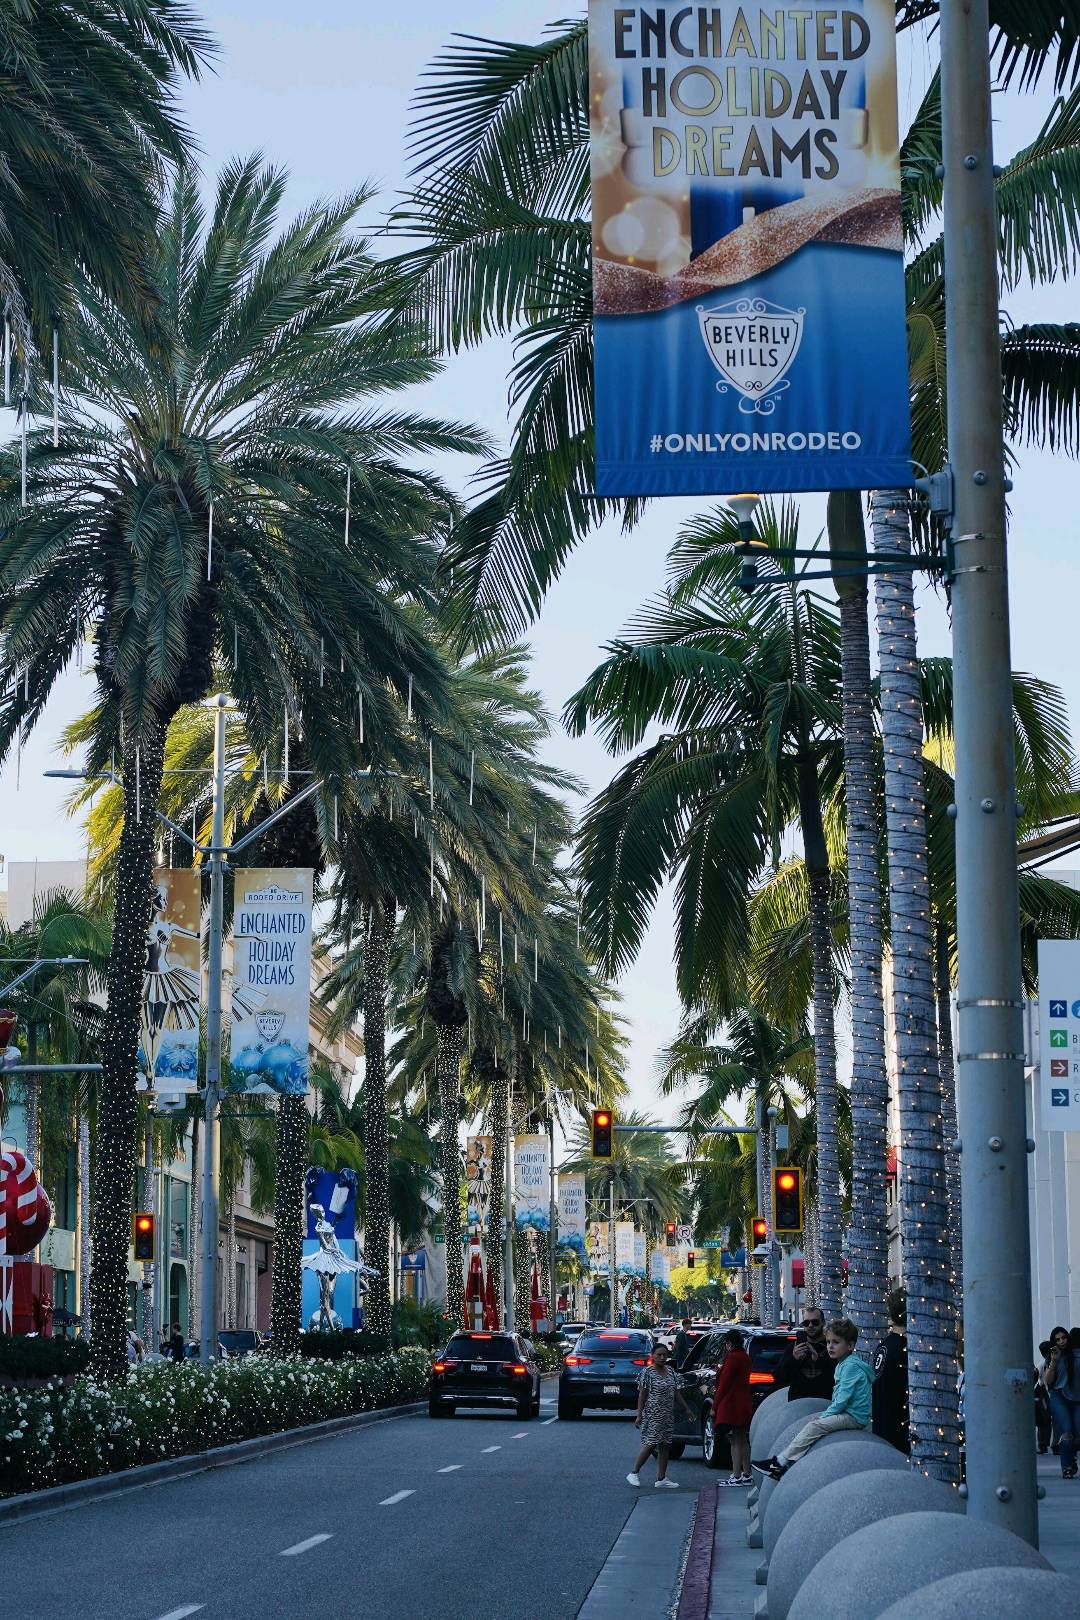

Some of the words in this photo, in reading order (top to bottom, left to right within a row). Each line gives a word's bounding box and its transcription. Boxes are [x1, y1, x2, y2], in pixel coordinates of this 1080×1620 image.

[614, 7, 871, 61] ENCHANTED
[642, 65, 848, 120] HOLIDAY
[653, 125, 840, 180] DREAMS
[712, 325, 791, 346] BEVERLY
[726, 348, 779, 368] HILLS
[649, 431, 862, 454] #ONLYONRODEO
[241, 913, 306, 934] ENCHANTED
[249, 941, 297, 962] HOLIDAY
[248, 964, 295, 985] DREAMS
[1073, 1035, 1080, 1044] B
